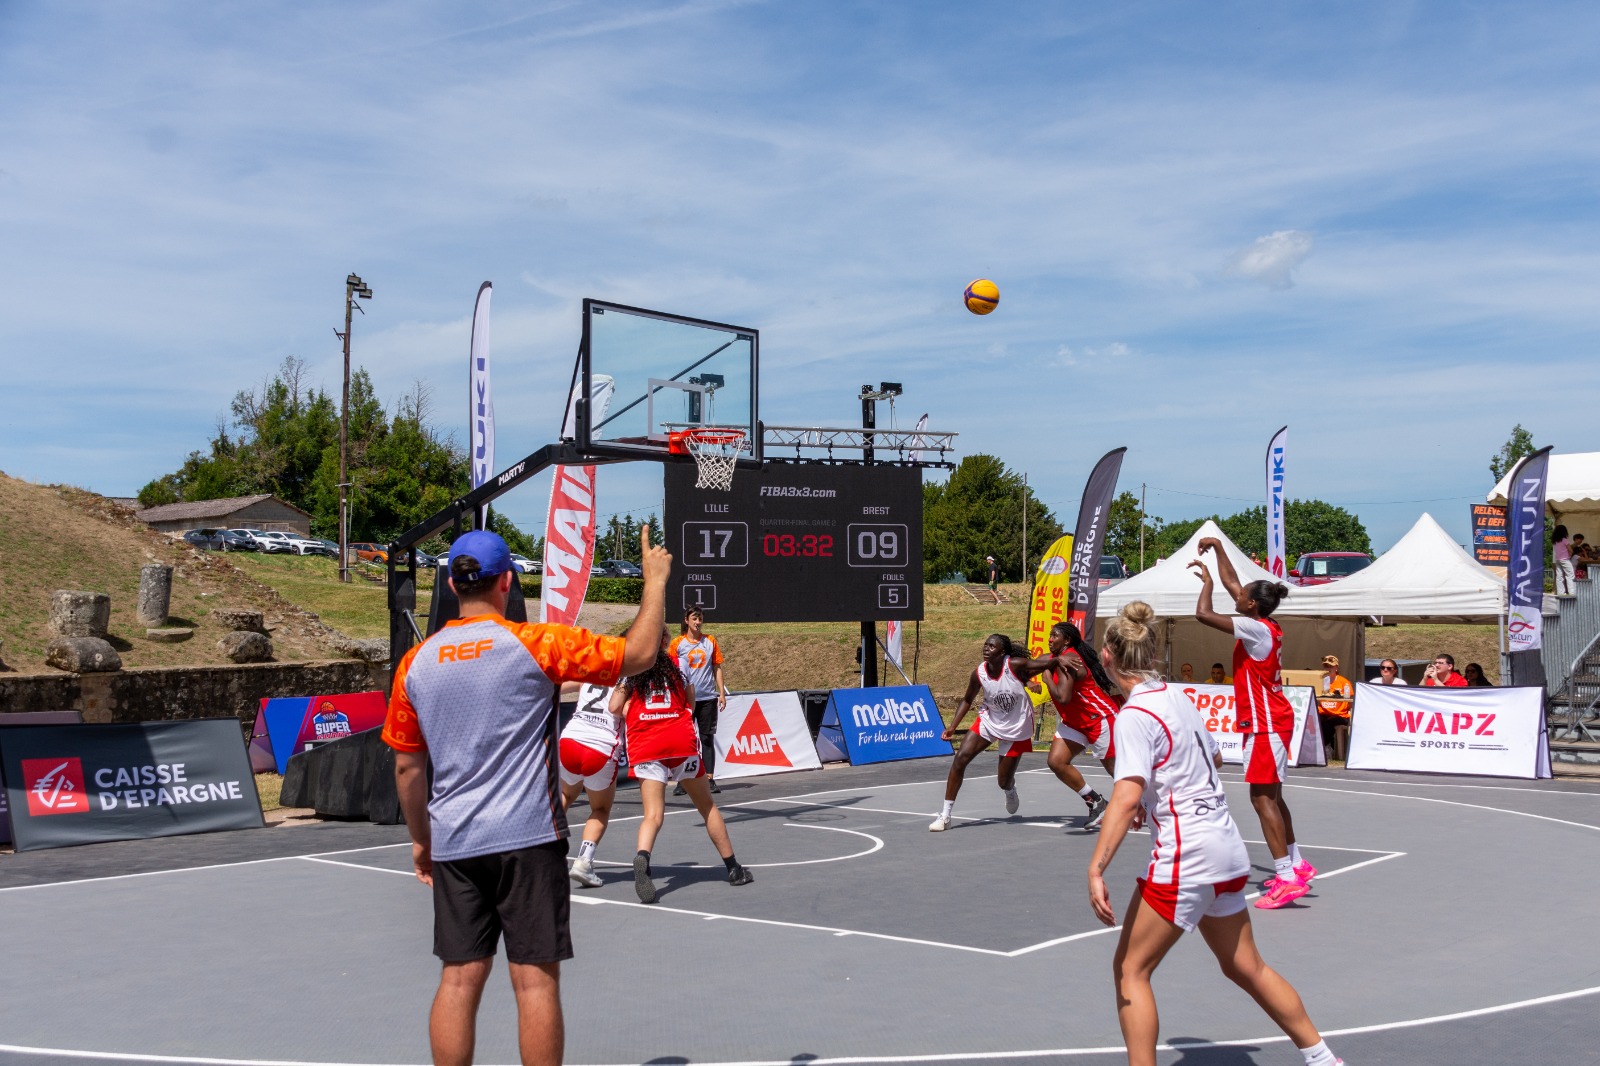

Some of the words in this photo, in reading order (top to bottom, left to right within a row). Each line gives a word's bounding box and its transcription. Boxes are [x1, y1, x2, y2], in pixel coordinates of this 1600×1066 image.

[760, 486, 837, 498] FIBA3x3.com
[704, 504, 730, 513] LILLE
[862, 506, 890, 516] BREST
[699, 530, 733, 558] 17
[763, 534, 834, 557] 03:32
[857, 531, 898, 559] 09
[1515, 479, 1541, 603] AUTUN
[694, 588, 705, 605] 1
[888, 588, 899, 604] 5
[1035, 585, 1048, 611] DE
[438, 638, 494, 664] REF
[582, 684, 610, 714] 2
[852, 698, 930, 727] molten
[1394, 710, 1496, 736] WAPZ
[315, 721, 352, 736] SUPER
[858, 732, 872, 746] For
[874, 730, 889, 744] the
[890, 728, 908, 742] real
[909, 730, 935, 746] game
[732, 733, 778, 757] MAIF
[1221, 742, 1238, 751] par
[1420, 740, 1466, 750] SPORTS
[94, 763, 188, 789] CAISSE
[98, 780, 244, 811] D'EPARGNE
